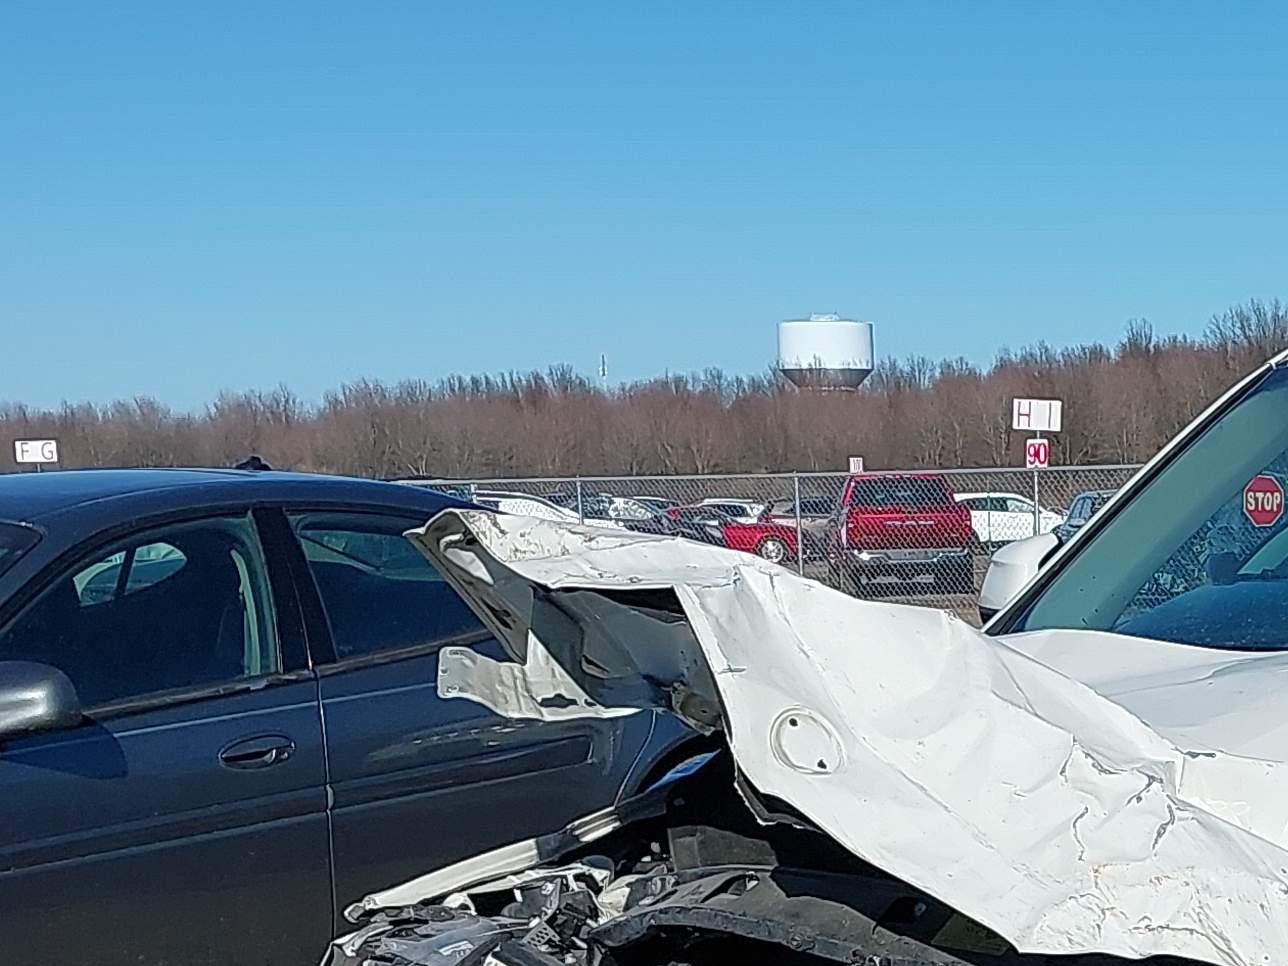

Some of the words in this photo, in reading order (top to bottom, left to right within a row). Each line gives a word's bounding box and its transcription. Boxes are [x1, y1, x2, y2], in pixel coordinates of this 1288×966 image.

[1017, 401, 1032, 428] H
[20, 442, 30, 461] F
[41, 441, 54, 461] G
[1027, 442, 1048, 465] 90
[1246, 491, 1281, 512] STOP
